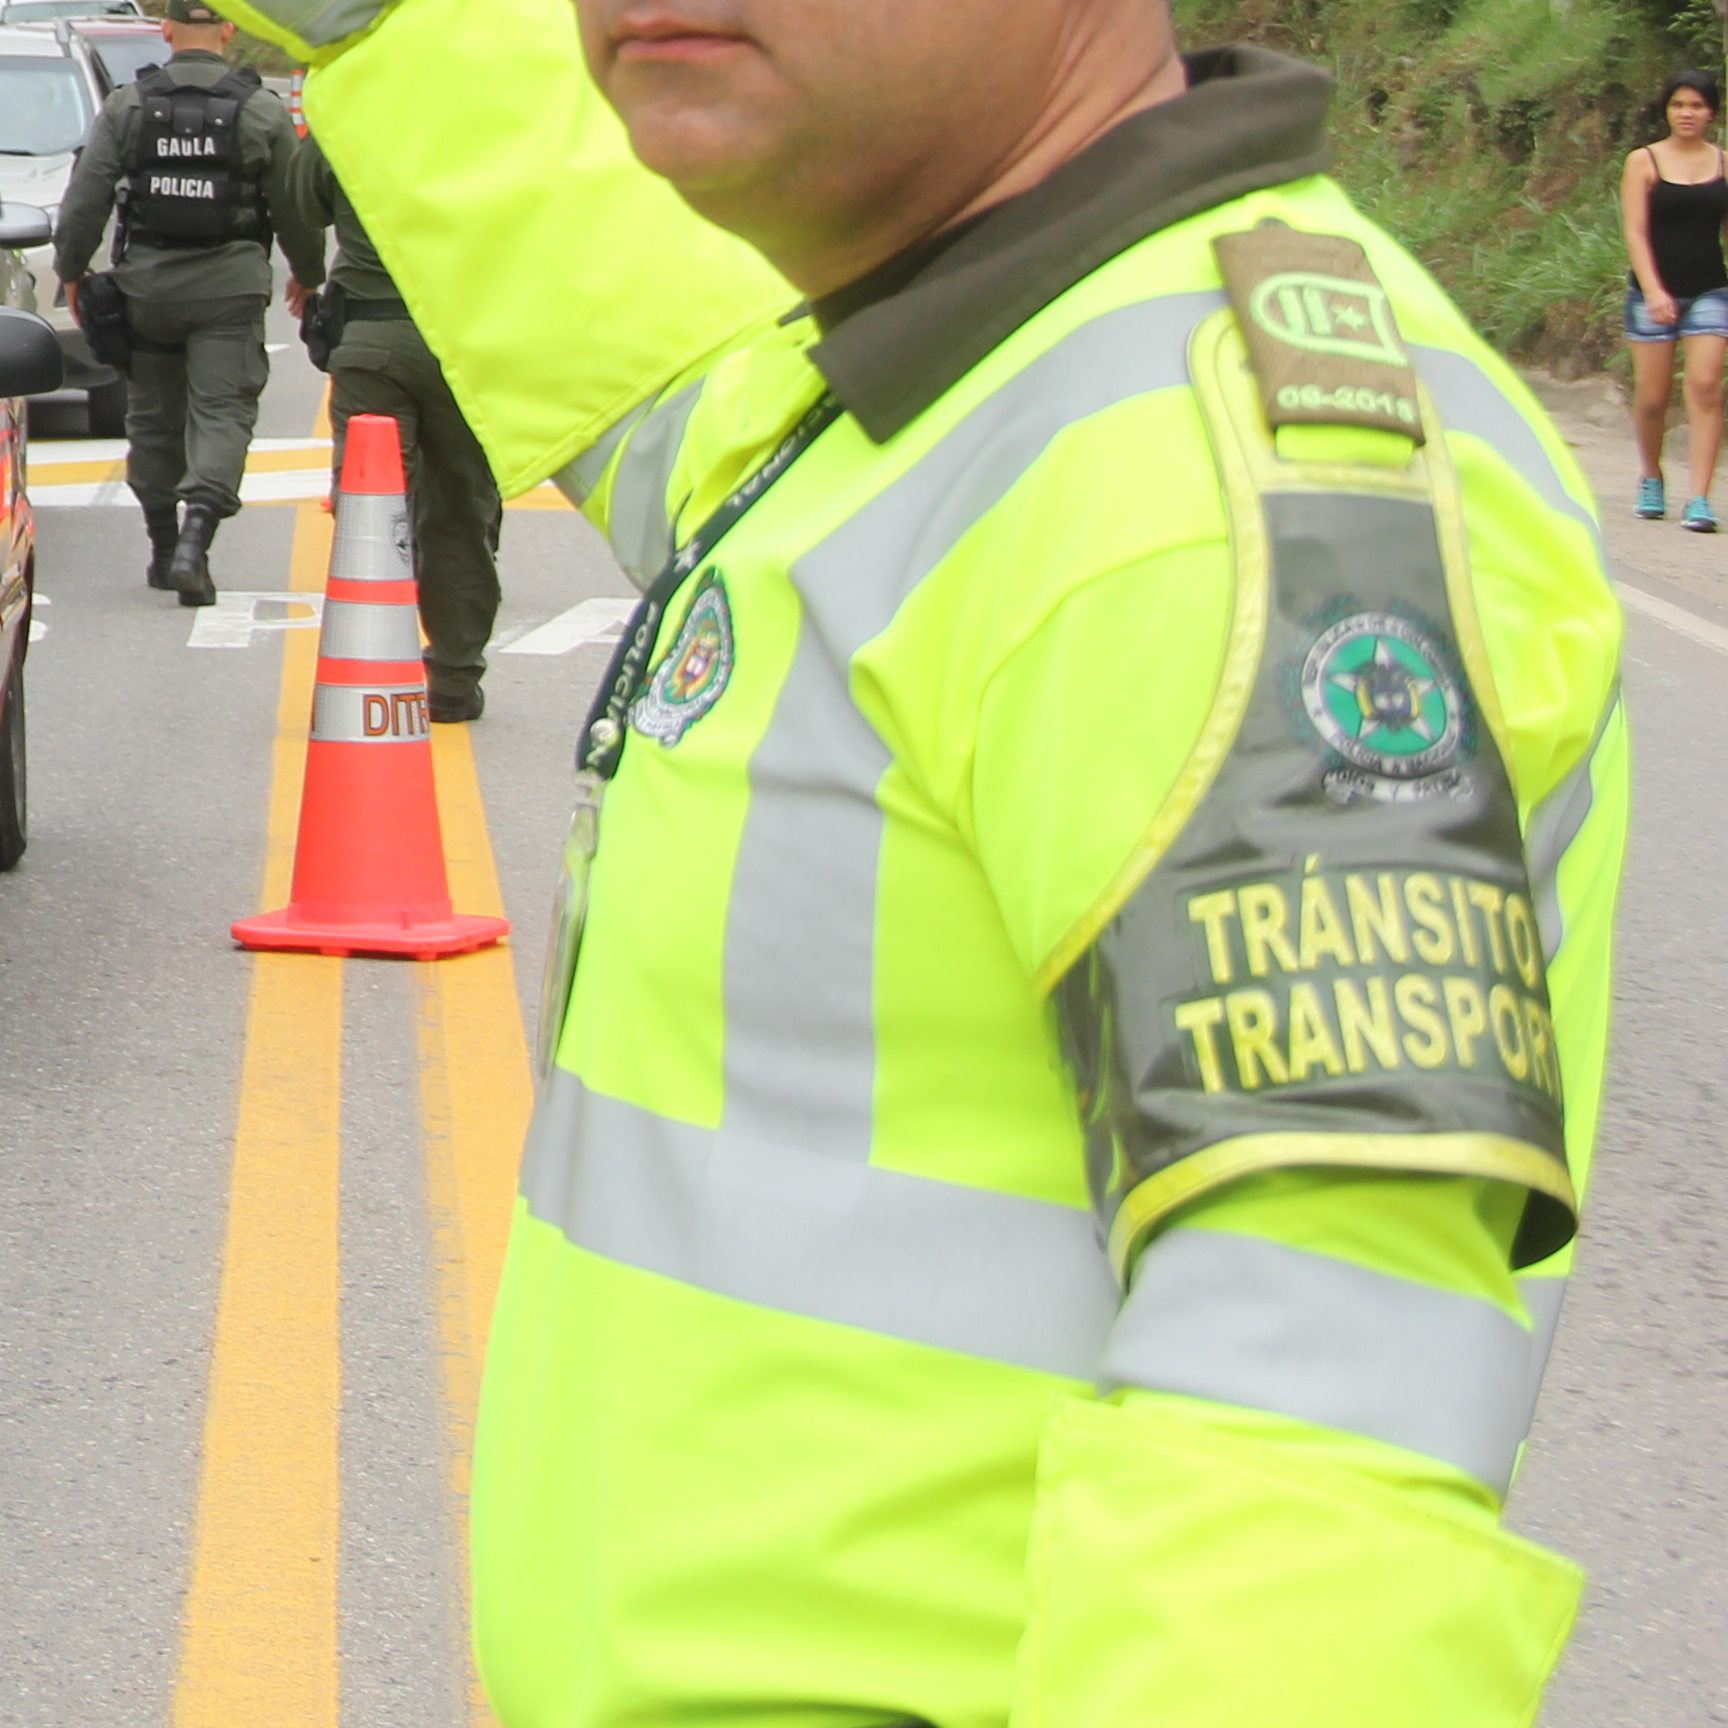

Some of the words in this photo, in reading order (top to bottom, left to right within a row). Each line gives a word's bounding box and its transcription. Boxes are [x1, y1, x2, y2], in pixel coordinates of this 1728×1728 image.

[156, 136, 216, 157] GAULA
[150, 176, 215, 199] POLICIA
[1187, 852, 1541, 989] TRÁNSITO
[1174, 974, 1562, 1107] TRANSPOR
